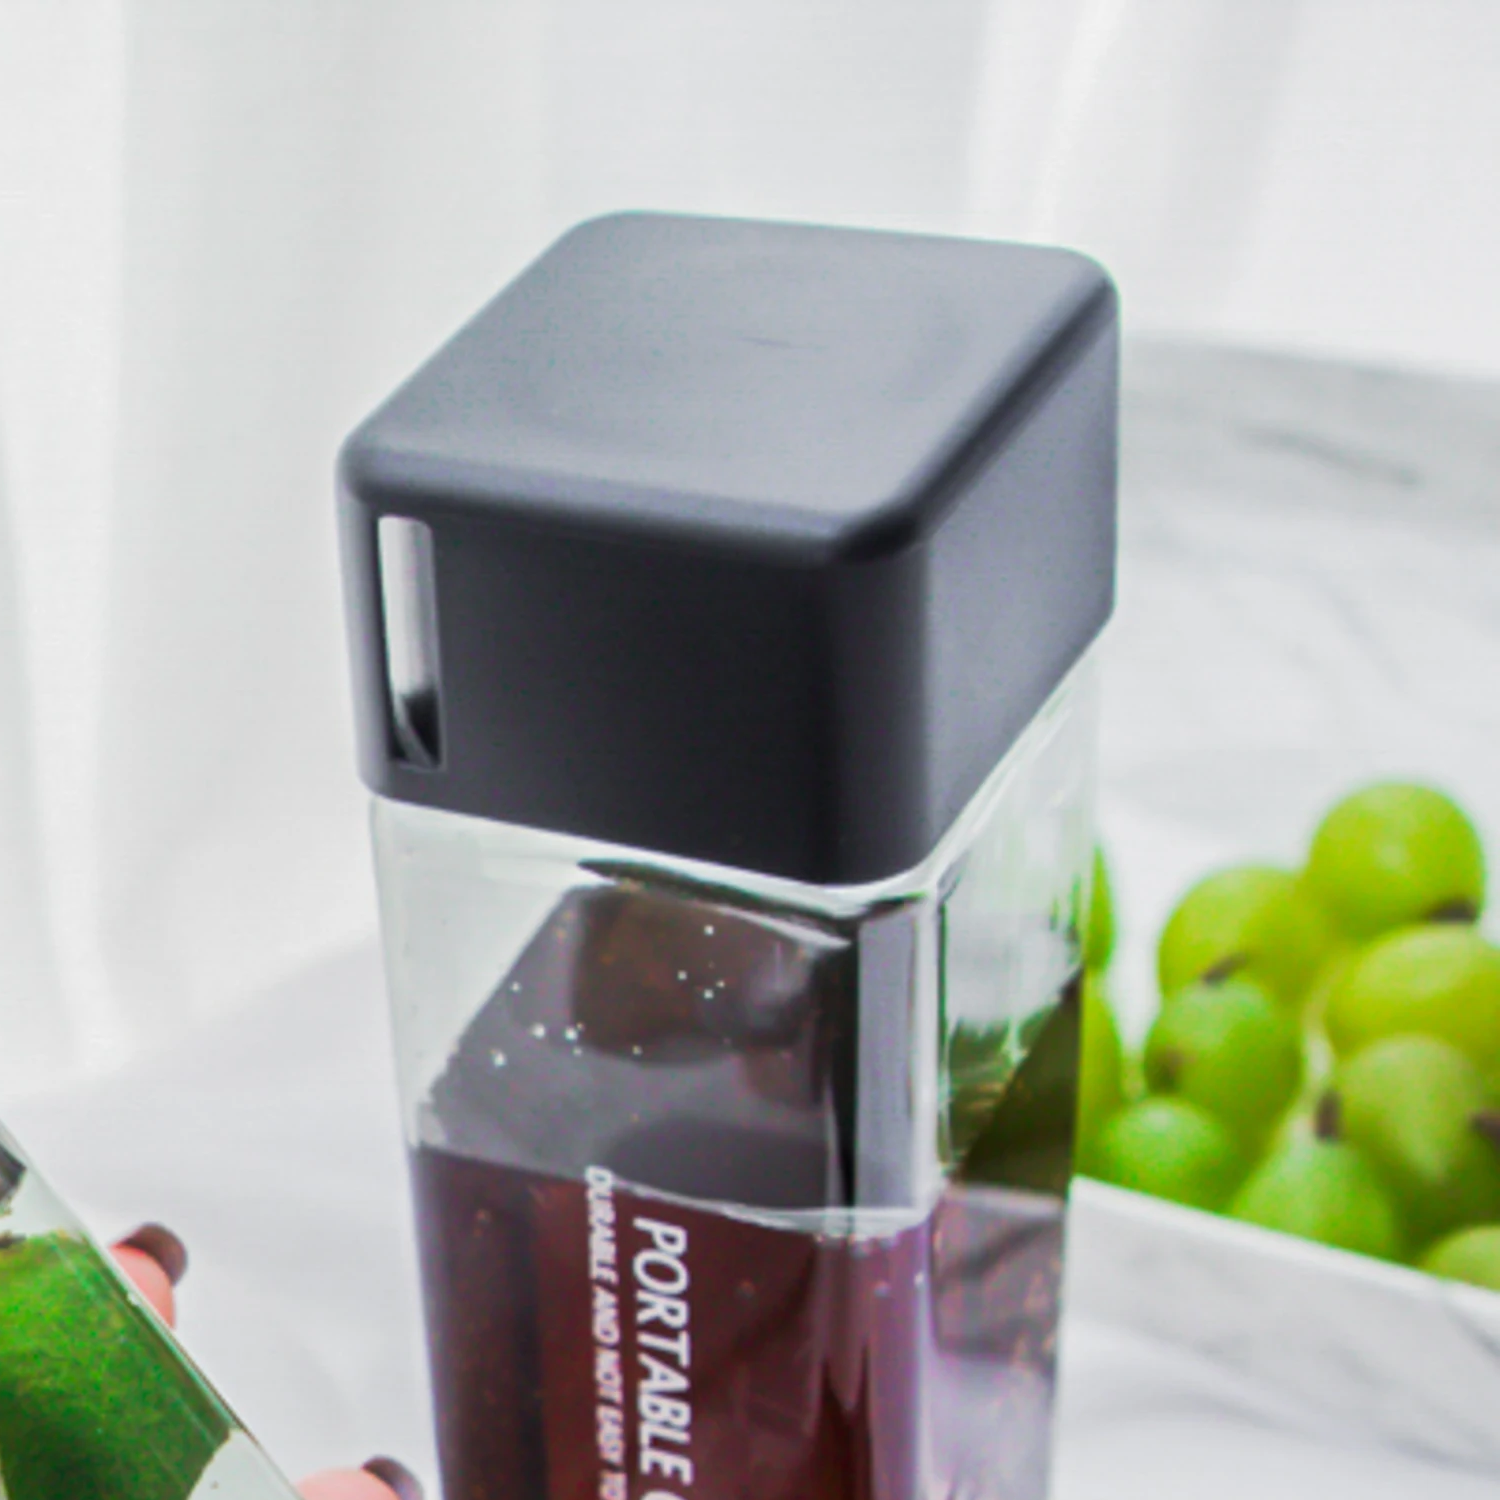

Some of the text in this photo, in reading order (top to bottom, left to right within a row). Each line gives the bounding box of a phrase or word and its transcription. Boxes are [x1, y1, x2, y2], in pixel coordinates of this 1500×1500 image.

[585, 1165, 619, 1286] DURABLE
[592, 1285, 621, 1346] AND
[632, 1217, 692, 1485] PORTABLE
